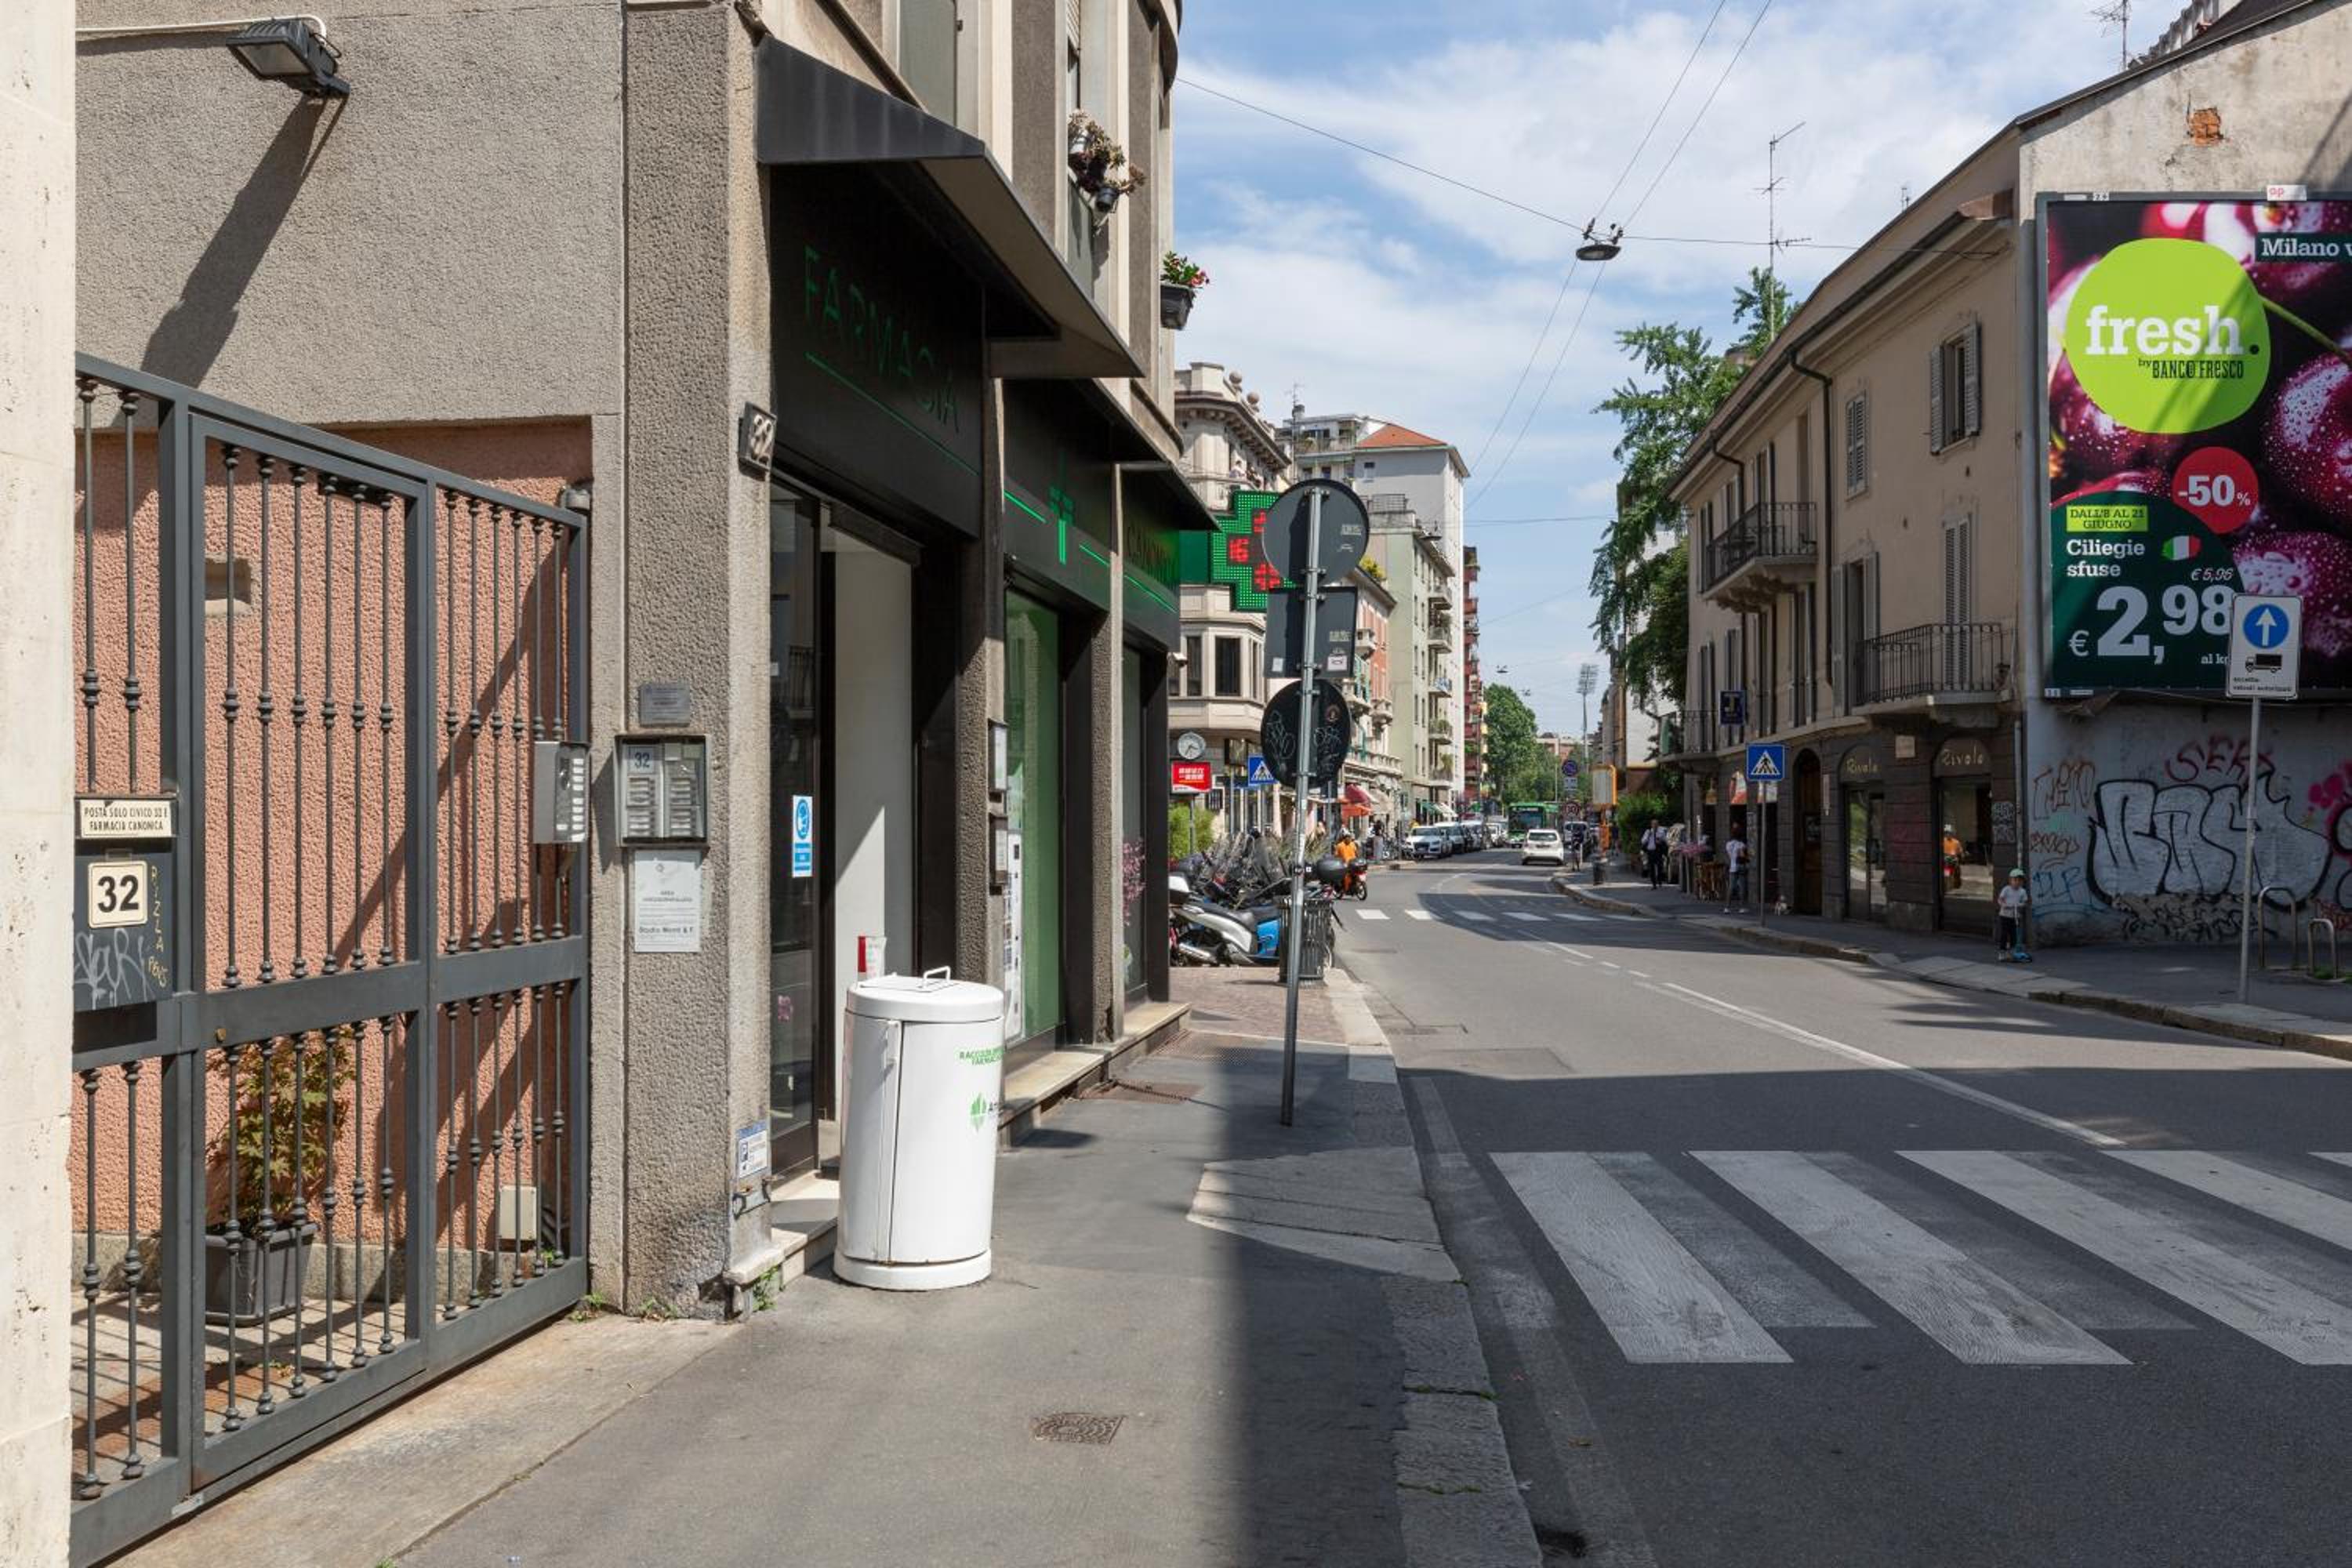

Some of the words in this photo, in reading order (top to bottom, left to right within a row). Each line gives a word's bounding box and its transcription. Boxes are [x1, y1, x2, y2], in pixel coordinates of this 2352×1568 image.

[2261, 238, 2339, 256] Milano
[2138, 358, 2152, 368] by
[2113, 509, 2129, 518] AL
[2132, 509, 2144, 518] 21
[2082, 520, 2132, 529] GIUGNO
[2066, 539, 2146, 559] Ciliegie
[2067, 560, 2122, 577] sfuse
[2068, 630, 2090, 657] €
[2201, 653, 2213, 665] al
[633, 752, 651, 769] 32
[84, 806, 107, 818] POSTA
[109, 807, 127, 818] SOLO
[129, 807, 152, 818] CIVICO
[89, 821, 126, 831] FARMACIA
[128, 820, 163, 831] CANONICA
[97, 874, 140, 913] 32
